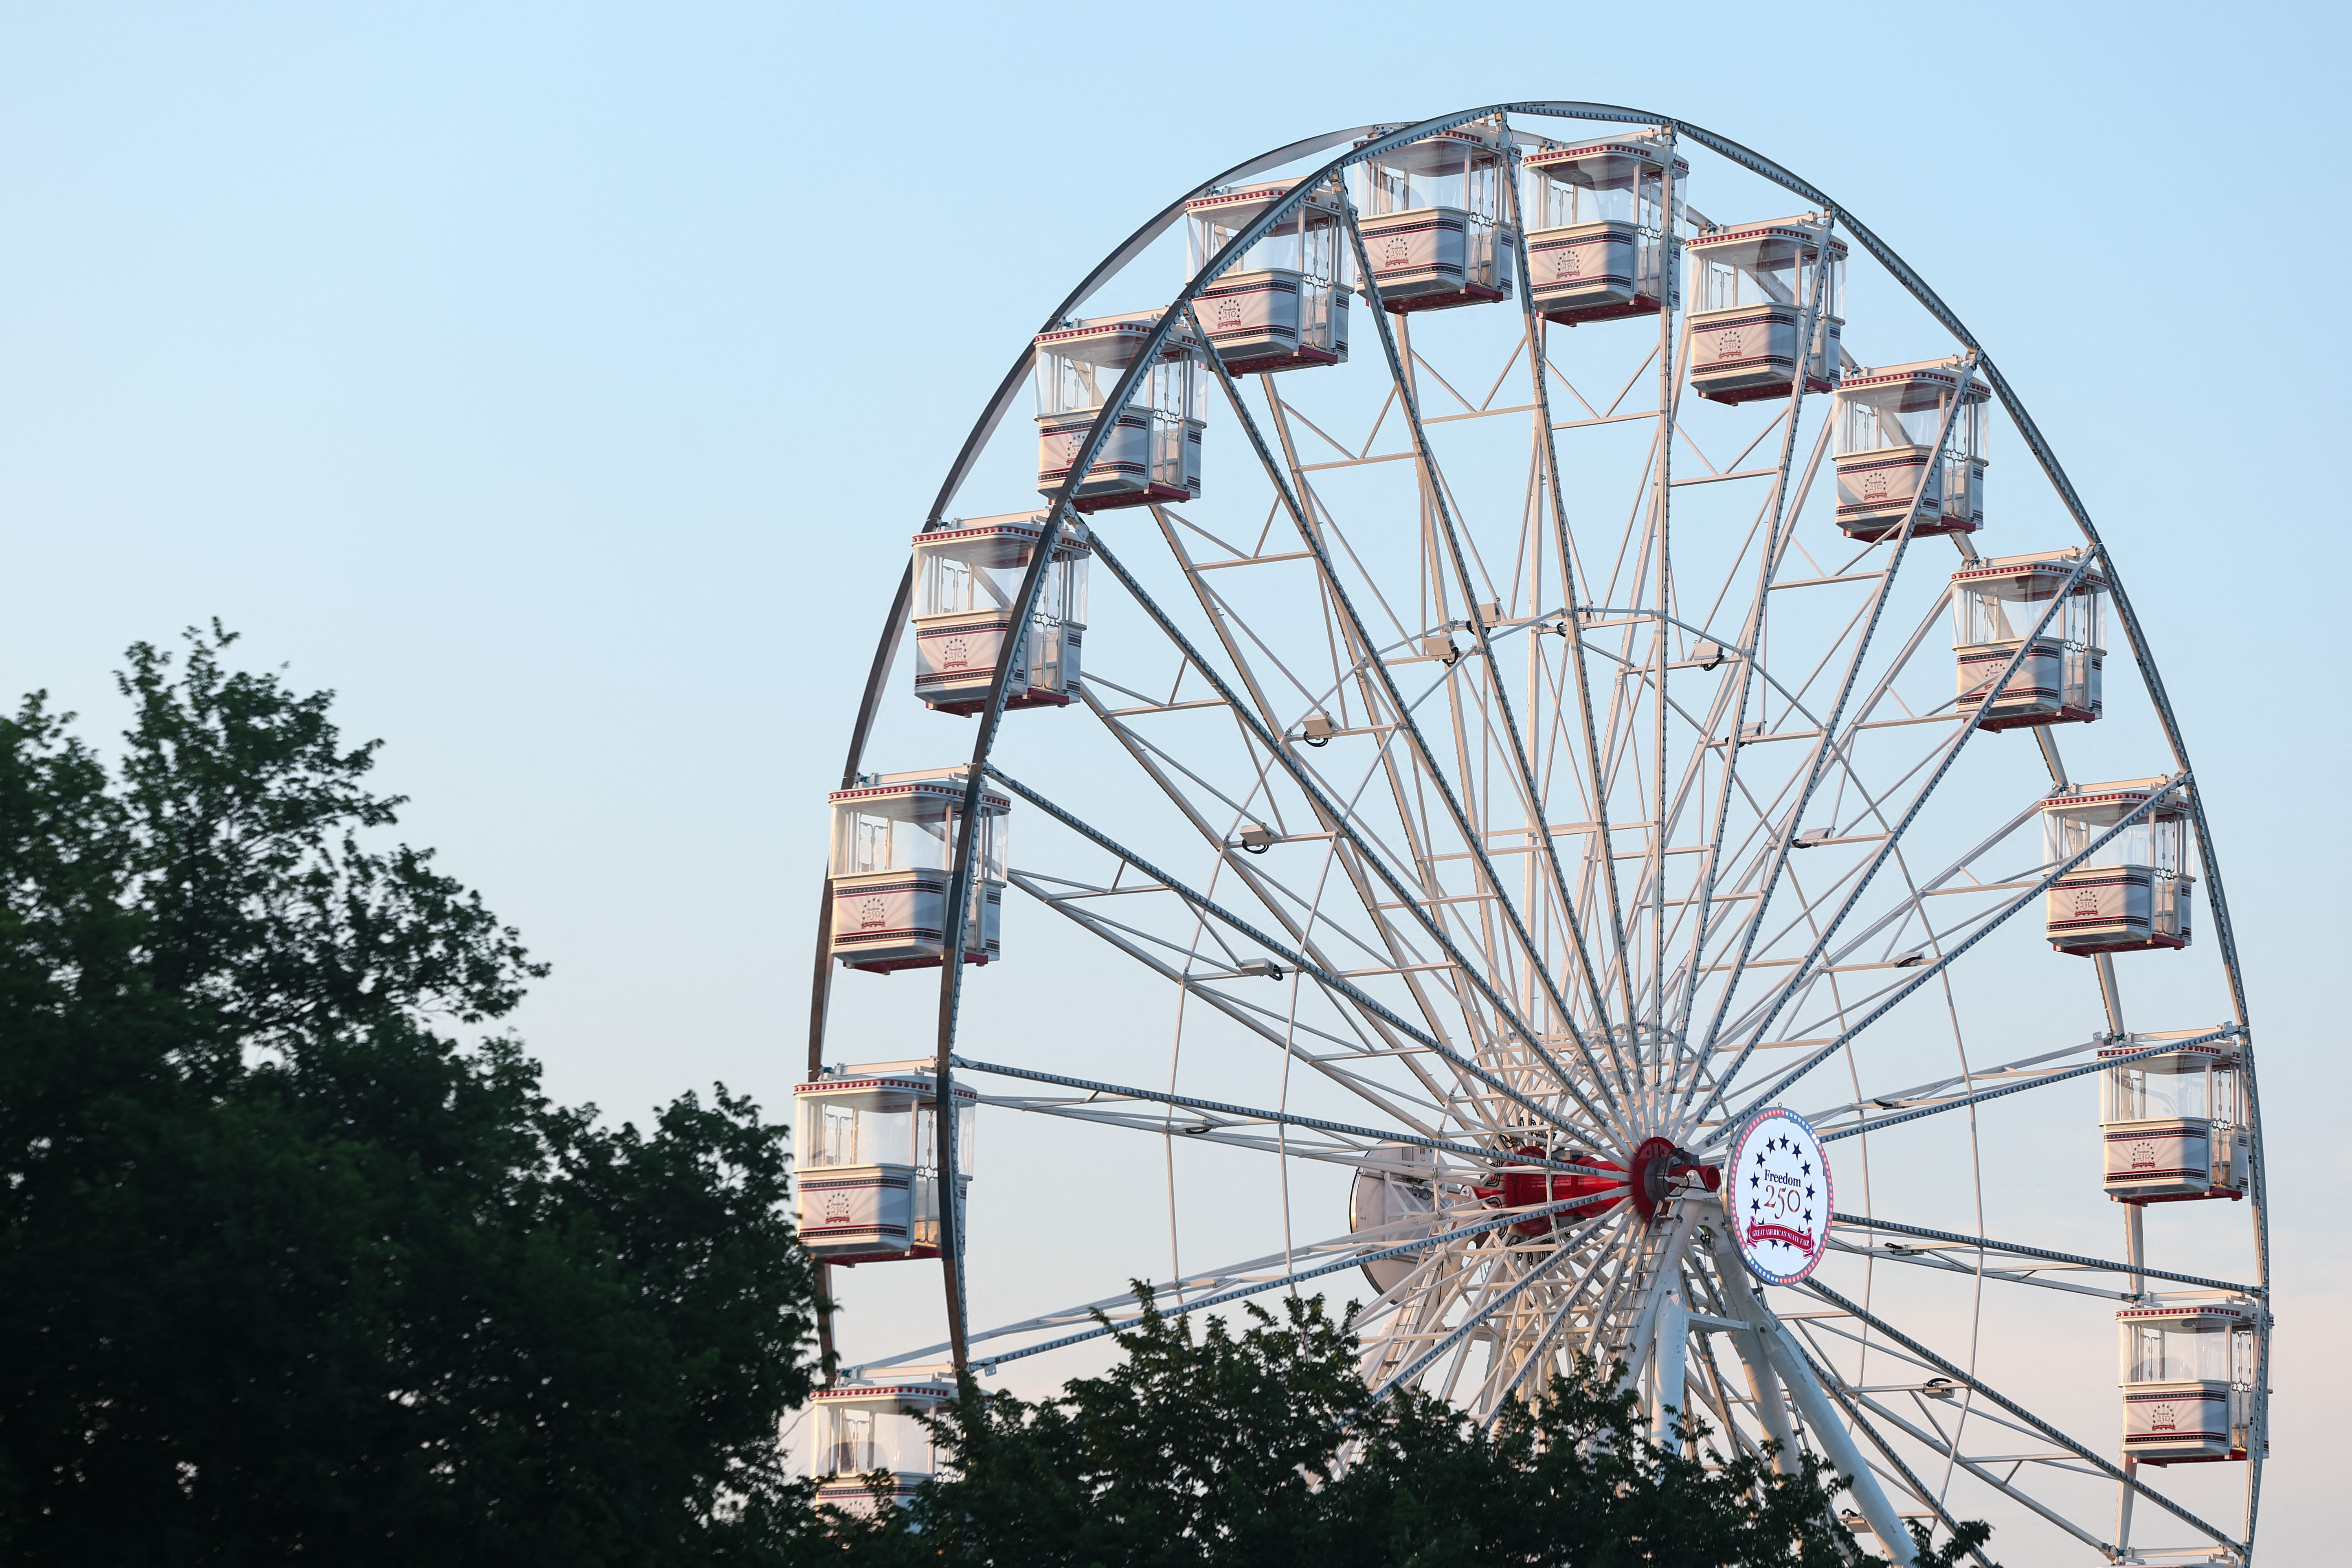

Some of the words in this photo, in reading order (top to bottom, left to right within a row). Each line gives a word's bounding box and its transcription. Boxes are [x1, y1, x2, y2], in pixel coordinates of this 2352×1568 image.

[1390, 249, 1403, 258] 250
[1562, 262, 1575, 271] 250
[1223, 311, 1236, 320] 250
[1724, 342, 1736, 351] 250
[1869, 484, 1882, 492] 250
[949, 651, 962, 660] 250
[867, 911, 880, 920] 250
[1764, 1169, 1801, 1187] Freedom
[1764, 1185, 1801, 1219] 250
[831, 1206, 844, 1215] 250
[1765, 1229, 1787, 1238] AMERICAN
[1788, 1232, 1800, 1243] STATE
[1800, 1238, 1810, 1247] FAIR
